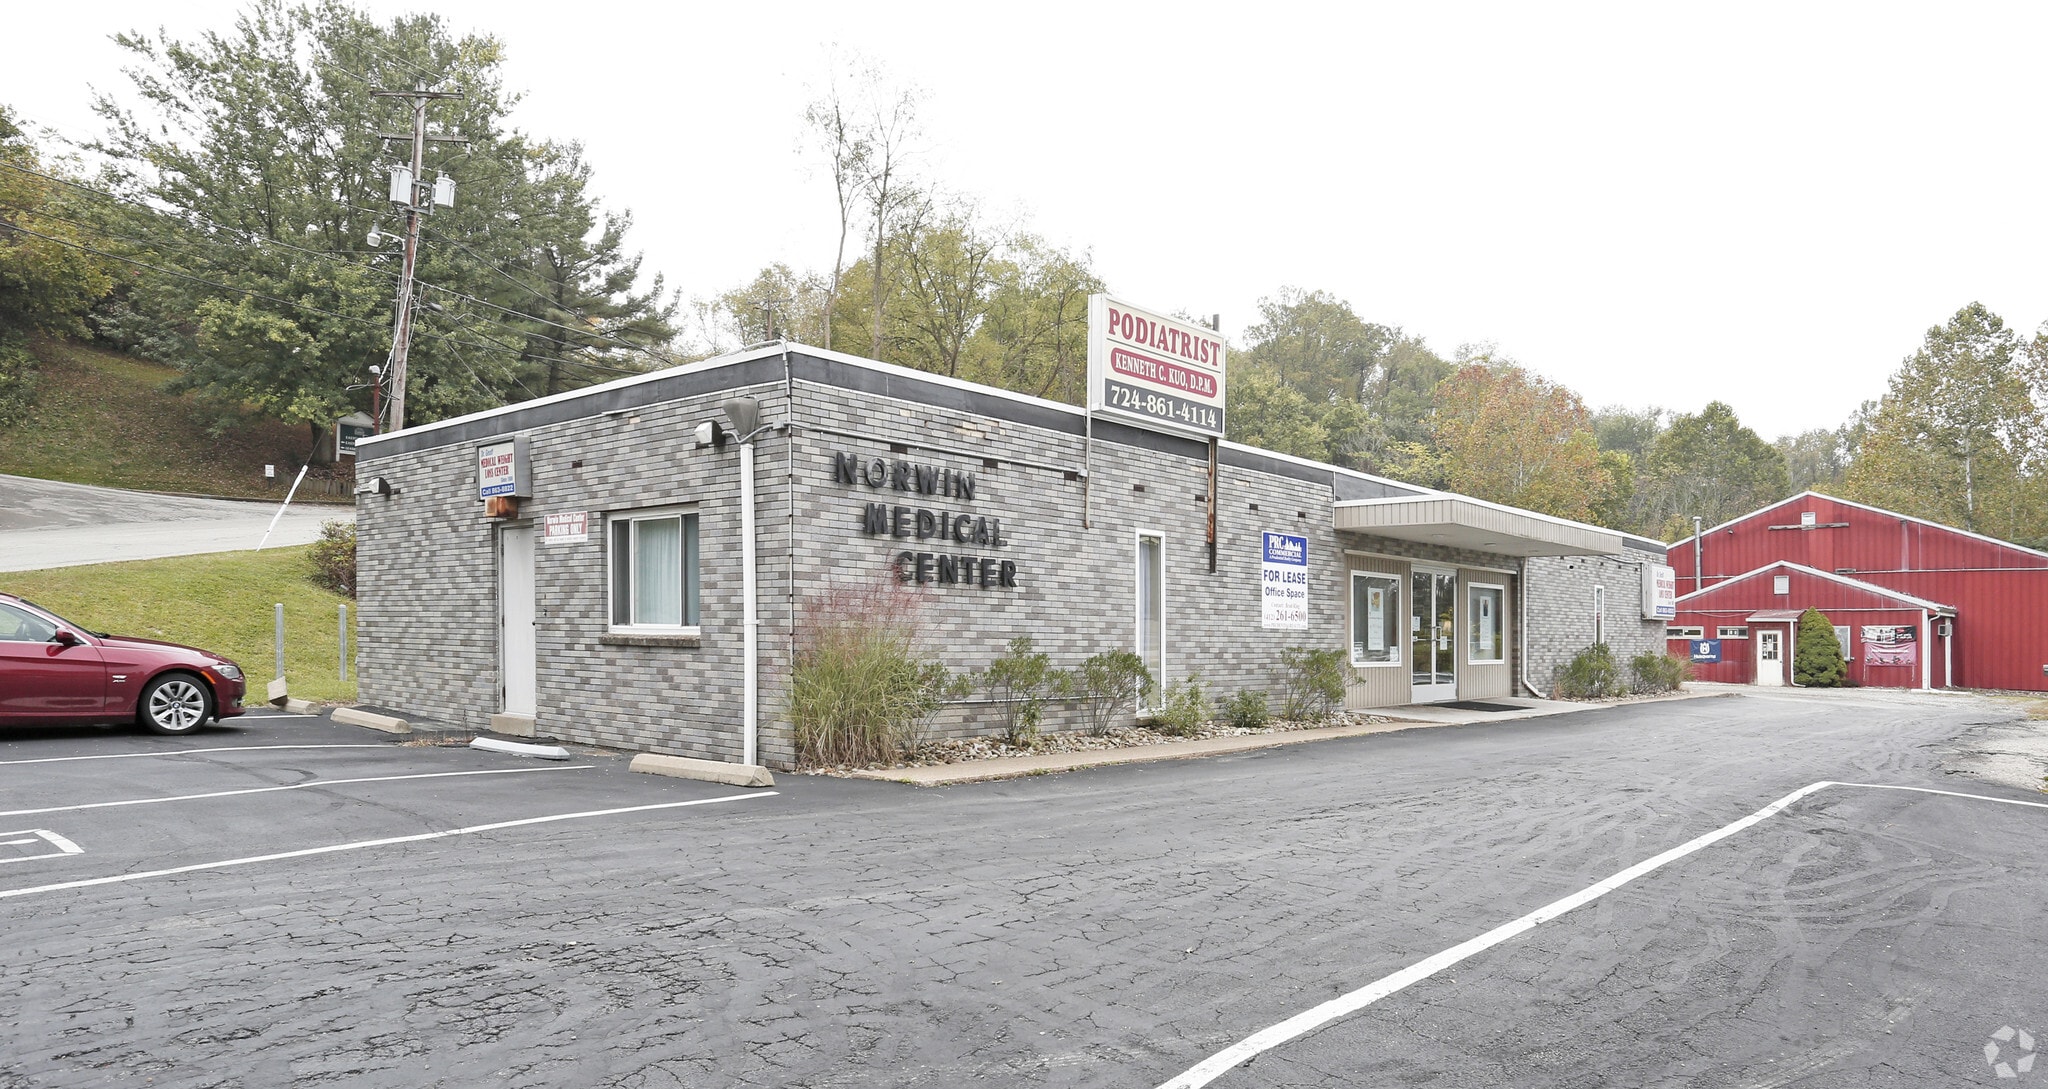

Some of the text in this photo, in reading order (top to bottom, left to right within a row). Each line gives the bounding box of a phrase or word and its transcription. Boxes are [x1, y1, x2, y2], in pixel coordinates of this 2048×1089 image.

[1108, 307, 1220, 367] PODIATRIST
[1115, 352, 1213, 394] KENNETH C. KUO, D.P.M.
[1110, 385, 1216, 428] 724-861-4114
[495, 465, 509, 476] CENTER
[836, 451, 975, 500] NORWIN
[549, 522, 583, 537] PARKING ONLY
[864, 503, 1008, 547] MEDICAL
[1268, 534, 1284, 550] PRC
[1268, 548, 1302, 559] COMMERCIAL
[895, 551, 1018, 589] CENTER
[1263, 569, 1306, 585] FOR LEASE
[1265, 586, 1305, 600] Office Space
[1276, 610, 1307, 622] 261-6500
